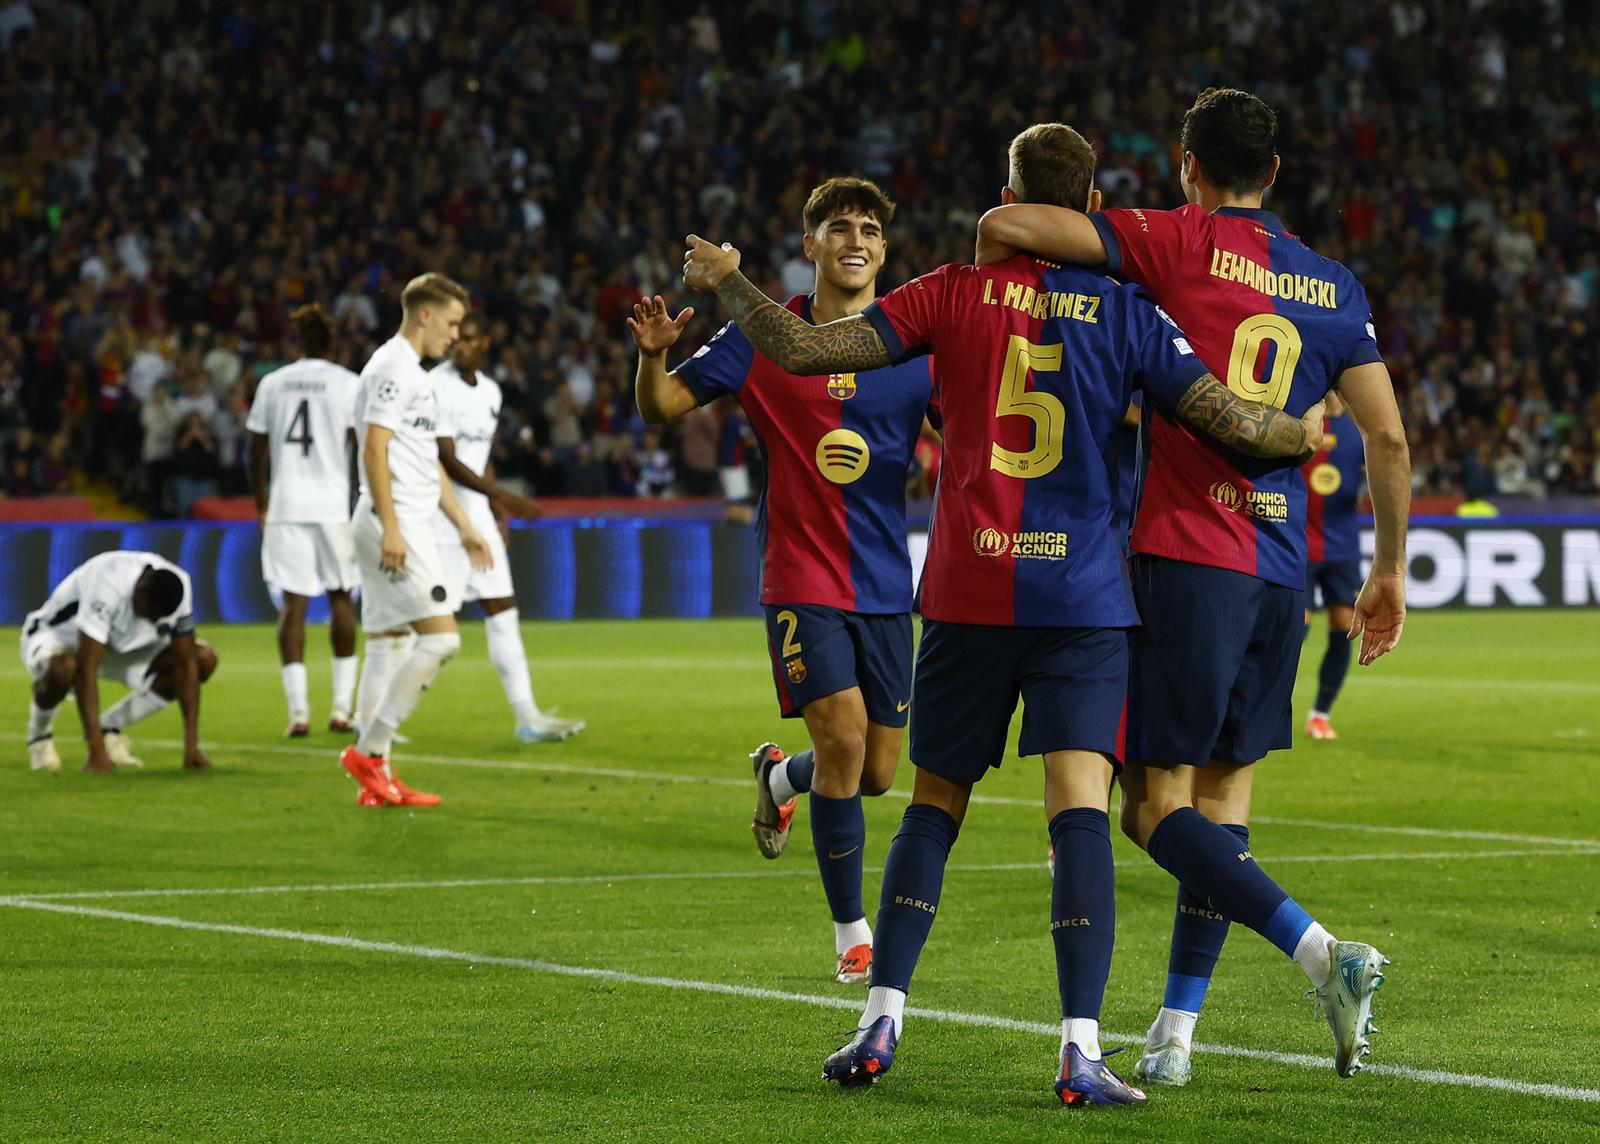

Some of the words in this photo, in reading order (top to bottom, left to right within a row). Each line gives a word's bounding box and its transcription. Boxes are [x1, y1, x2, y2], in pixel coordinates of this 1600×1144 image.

[983, 279, 998, 305] I.
[1210, 247, 1337, 309] LEWANDOWSKI
[1227, 313, 1303, 410] 9
[284, 398, 314, 457] 4
[990, 334, 1066, 479] 5
[1245, 502, 1288, 518] ACNUR
[1246, 491, 1287, 506] UNHCR
[1010, 543, 1067, 556] ACNUR
[1012, 532, 1068, 545] UNHCR
[1359, 528, 1546, 608] OR
[776, 609, 802, 658] 2
